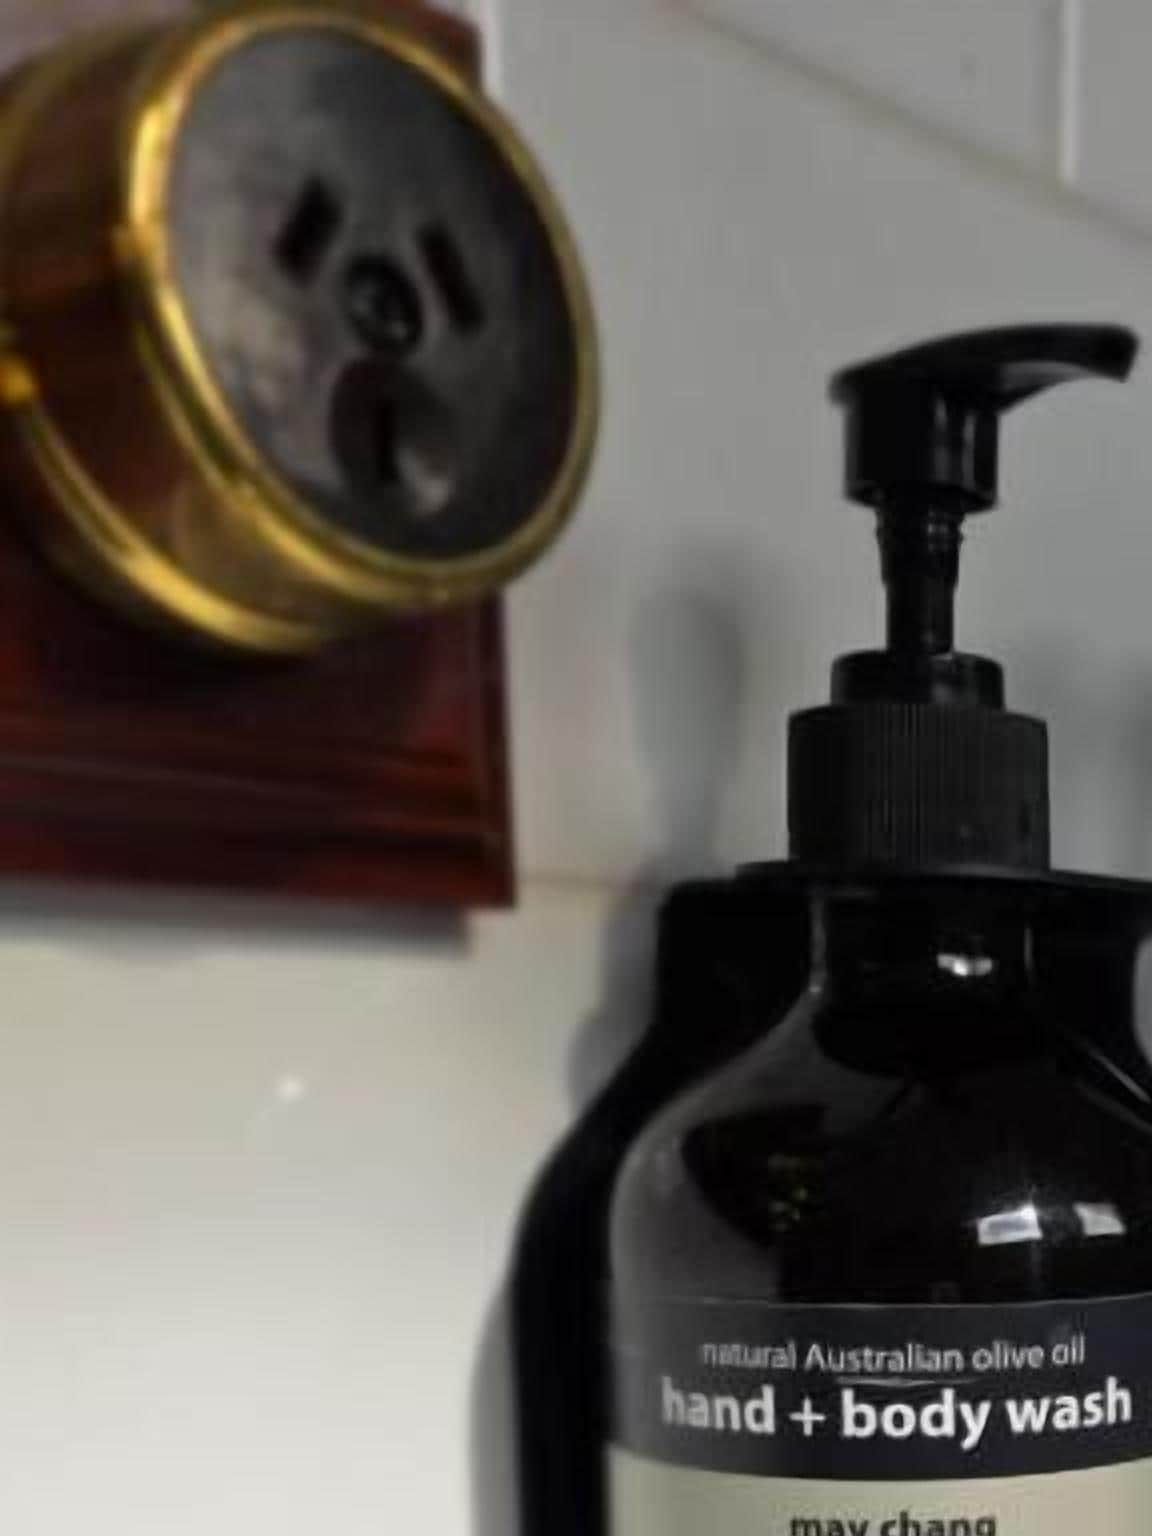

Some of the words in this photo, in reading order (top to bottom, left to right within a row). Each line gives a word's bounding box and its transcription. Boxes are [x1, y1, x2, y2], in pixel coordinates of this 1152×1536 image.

[702, 1343, 796, 1369] natural
[804, 1343, 964, 1373] Australian
[972, 1342, 1044, 1370] olive
[1051, 1336, 1085, 1366] oil
[662, 1377, 776, 1434] hand
[789, 1398, 826, 1436] +
[842, 1388, 992, 1451] body
[1006, 1376, 1133, 1434] wash
